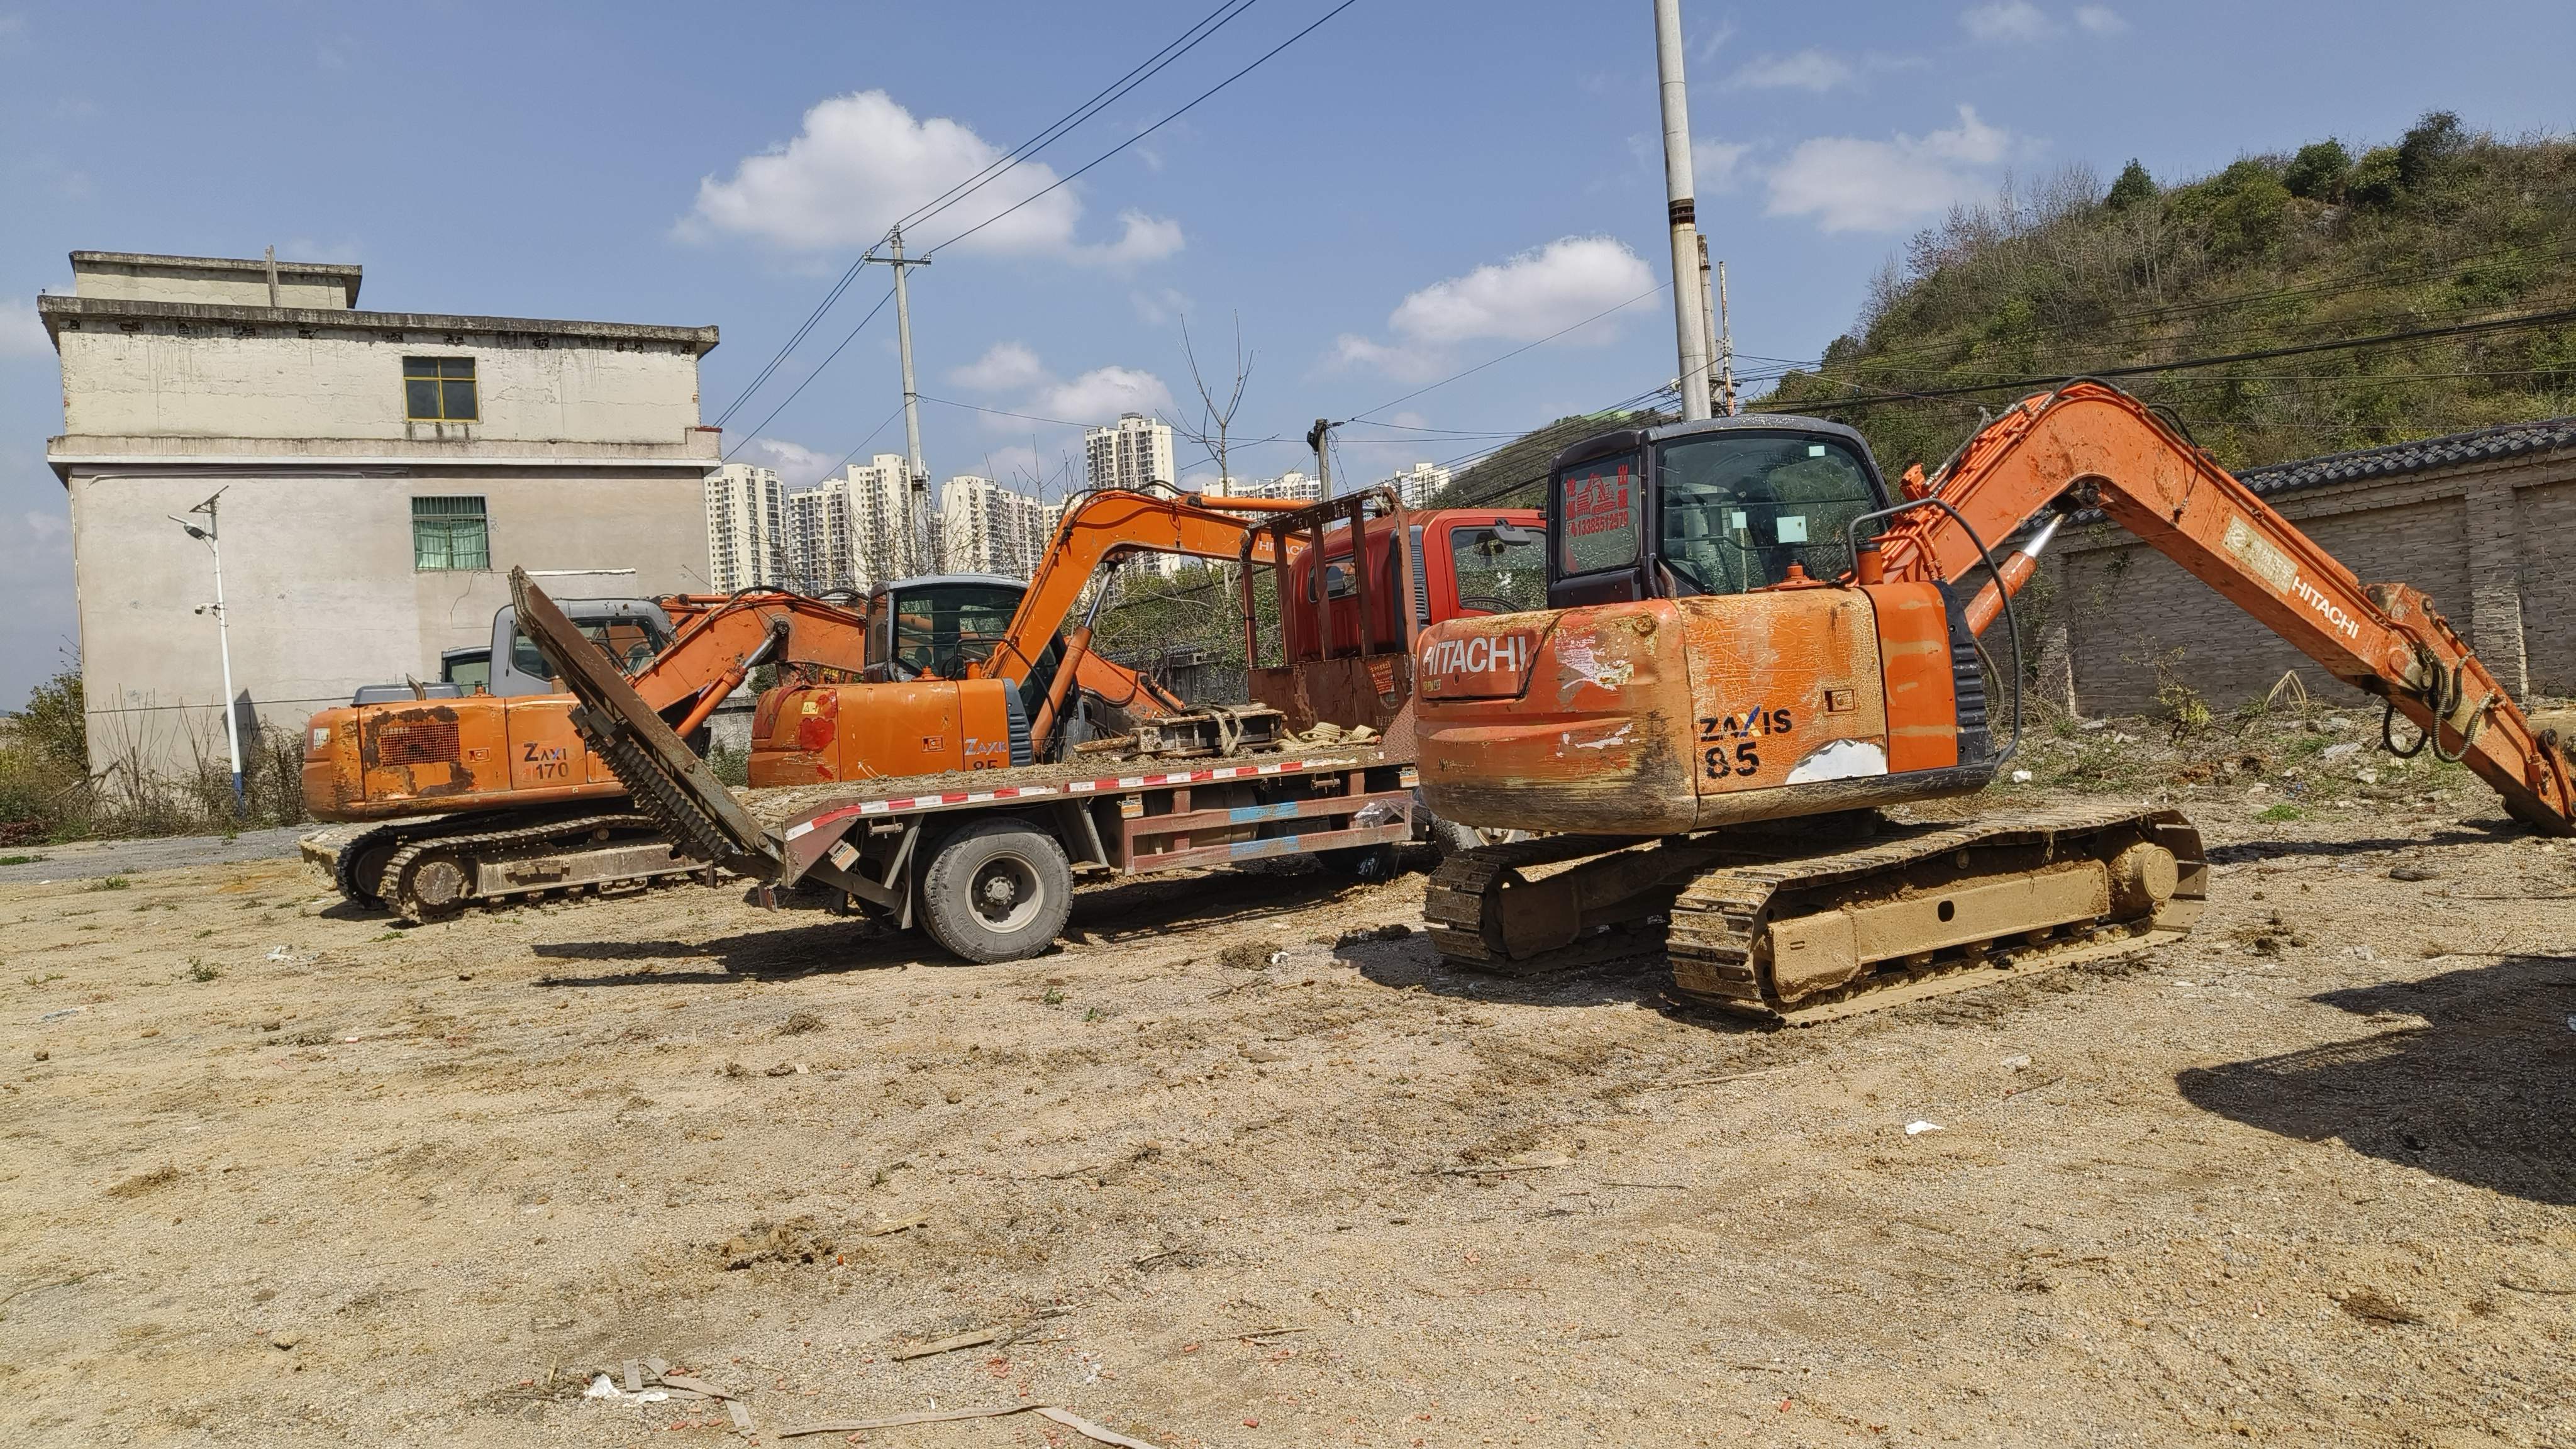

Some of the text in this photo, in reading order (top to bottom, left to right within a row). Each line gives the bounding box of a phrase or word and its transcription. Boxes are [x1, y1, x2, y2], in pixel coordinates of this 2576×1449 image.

[2291, 576, 2360, 640] HITACHI
[1423, 636, 1527, 677] HITACHI
[1699, 706, 1793, 743] ZAXIS
[536, 762, 569, 780] 170
[1705, 741, 1760, 780] 85
